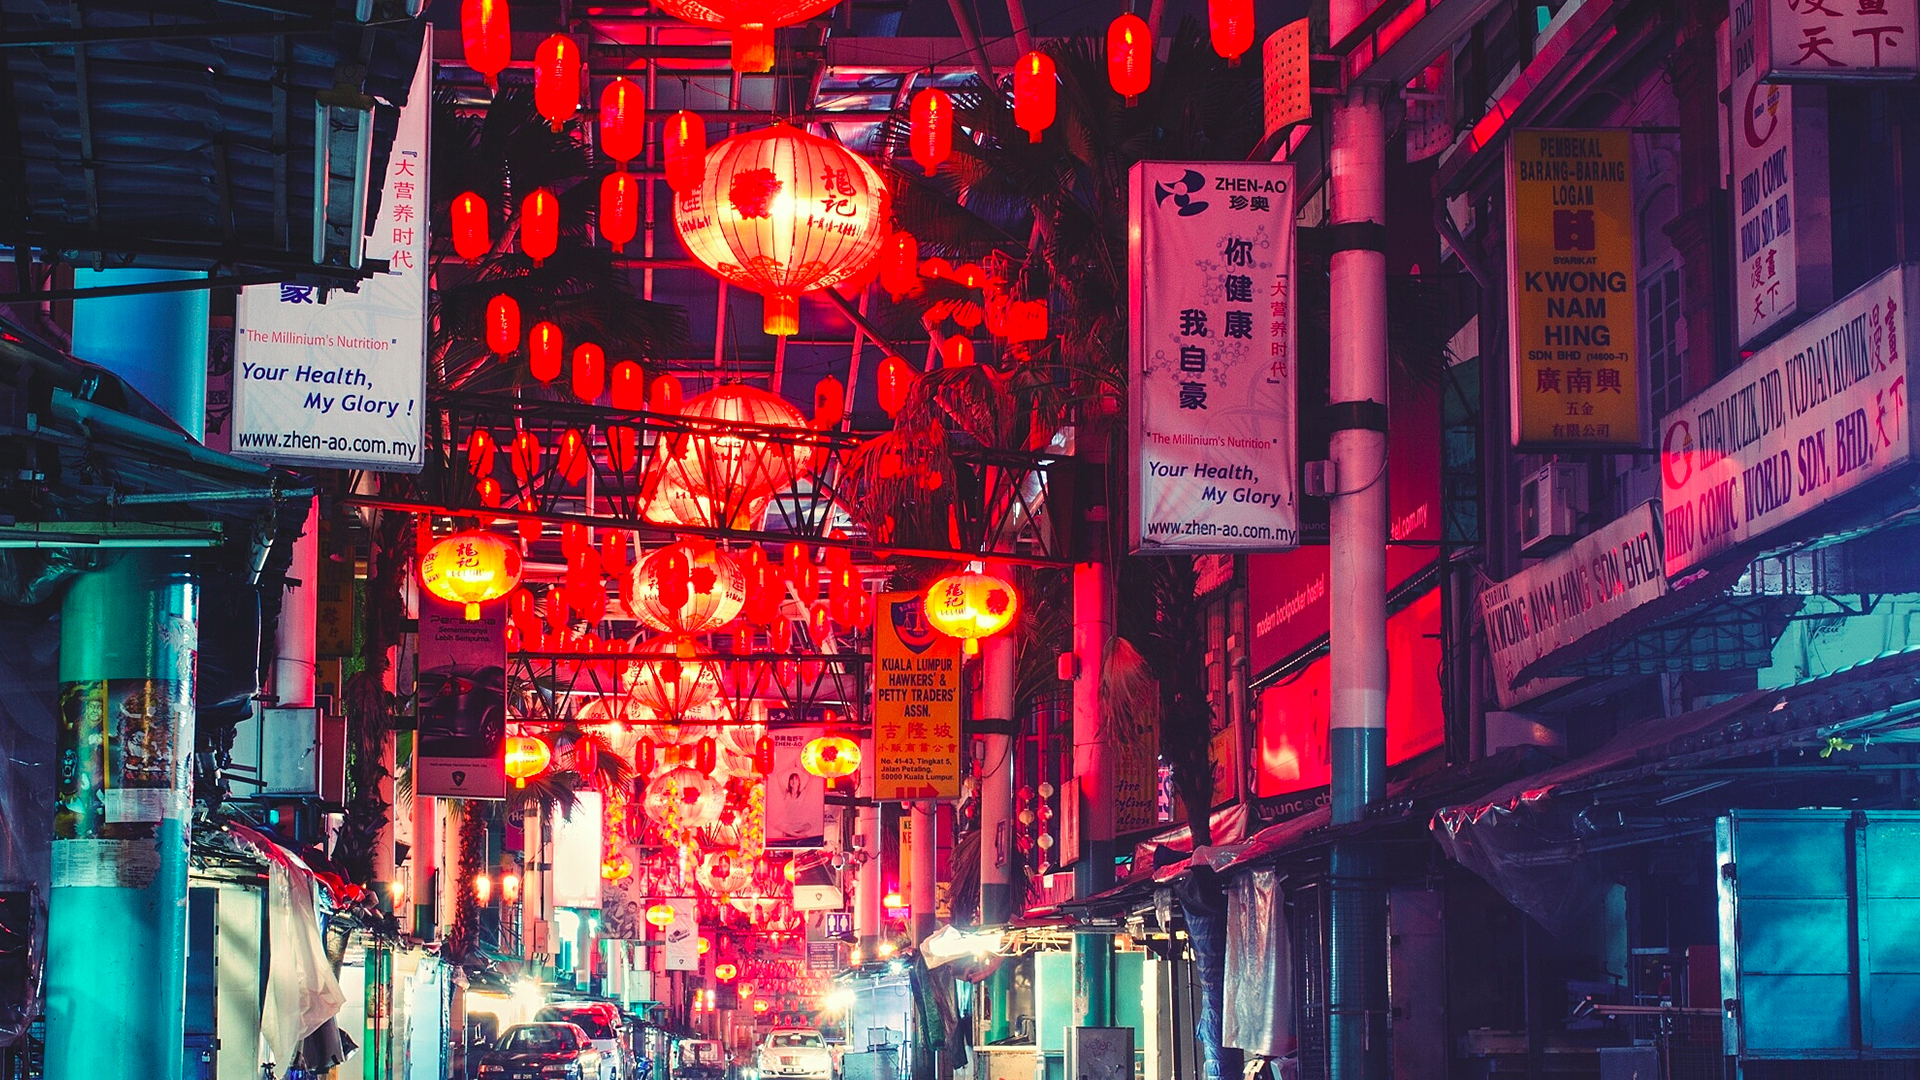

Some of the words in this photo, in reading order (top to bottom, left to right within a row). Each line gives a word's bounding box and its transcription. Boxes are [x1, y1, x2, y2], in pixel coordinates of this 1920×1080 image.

[1789, 26, 1905, 67] 天下
[1540, 137, 1603, 158] PEMBEKAL
[1520, 161, 1625, 182] BARANG-BARANG
[1741, 168, 1760, 216] HIRO
[1762, 145, 1788, 199] COMIC
[1215, 178, 1287, 193] ZHEN-AO
[1553, 185, 1594, 206] LOGAM
[1553, 256, 1597, 265] SYARIKAT
[1224, 238, 1253, 339] 你健康
[1525, 271, 1627, 293] KWONG
[1547, 298, 1606, 318] NAM
[1752, 281, 1780, 325] 天下
[271, 331, 334, 347] Millinium's
[1545, 325, 1610, 346] HING
[1180, 309, 1208, 410] 我自豪
[1528, 351, 1553, 361] SDN
[1557, 351, 1582, 361] BHD
[241, 362, 289, 383] Your
[295, 366, 374, 391] Health,
[1536, 367, 1622, 395] 廣南興
[1698, 400, 1726, 471] KEDAI
[1725, 382, 1761, 454] MUZIK,
[1760, 368, 1786, 440] DVD,
[1785, 352, 1809, 420] VCD
[1807, 335, 1833, 409] DAN
[1831, 312, 1871, 396] KOMIK
[304, 394, 334, 414] My
[341, 395, 400, 417] Glory
[1565, 401, 1595, 416] 五金
[1172, 434, 1226, 447] Millinium's
[1552, 423, 1610, 438] 有限公司
[238, 431, 417, 461] www.zhen-ao.com.my
[1150, 461, 1189, 478] Your
[1194, 463, 1259, 484] Health,
[1665, 499, 1695, 562] HIRO
[1700, 476, 1739, 546] COMIC
[1742, 449, 1792, 523] WORLD
[1798, 428, 1831, 496] SDN.
[1835, 407, 1874, 478] BHD.
[1201, 486, 1228, 505] My
[1233, 488, 1281, 508] Glory
[1148, 520, 1297, 545] www.zhen-ao.com.my
[1488, 596, 1529, 653] KWONG
[1529, 580, 1559, 634] NAM
[1558, 565, 1594, 622] HING
[1622, 531, 1660, 590] BHD.
[1256, 613, 1276, 638] modern
[1306, 573, 1324, 605] hostel
[882, 658, 913, 671] KUALA
[916, 658, 952, 672] LUMPUR
[888, 673, 936, 686] HAWKERS'
[939, 674, 946, 686] &
[878, 689, 907, 701] PETTY
[911, 688, 956, 701] TRADERS'
[904, 705, 931, 717] ASSN.
[881, 722, 954, 740] 吉隆坡
